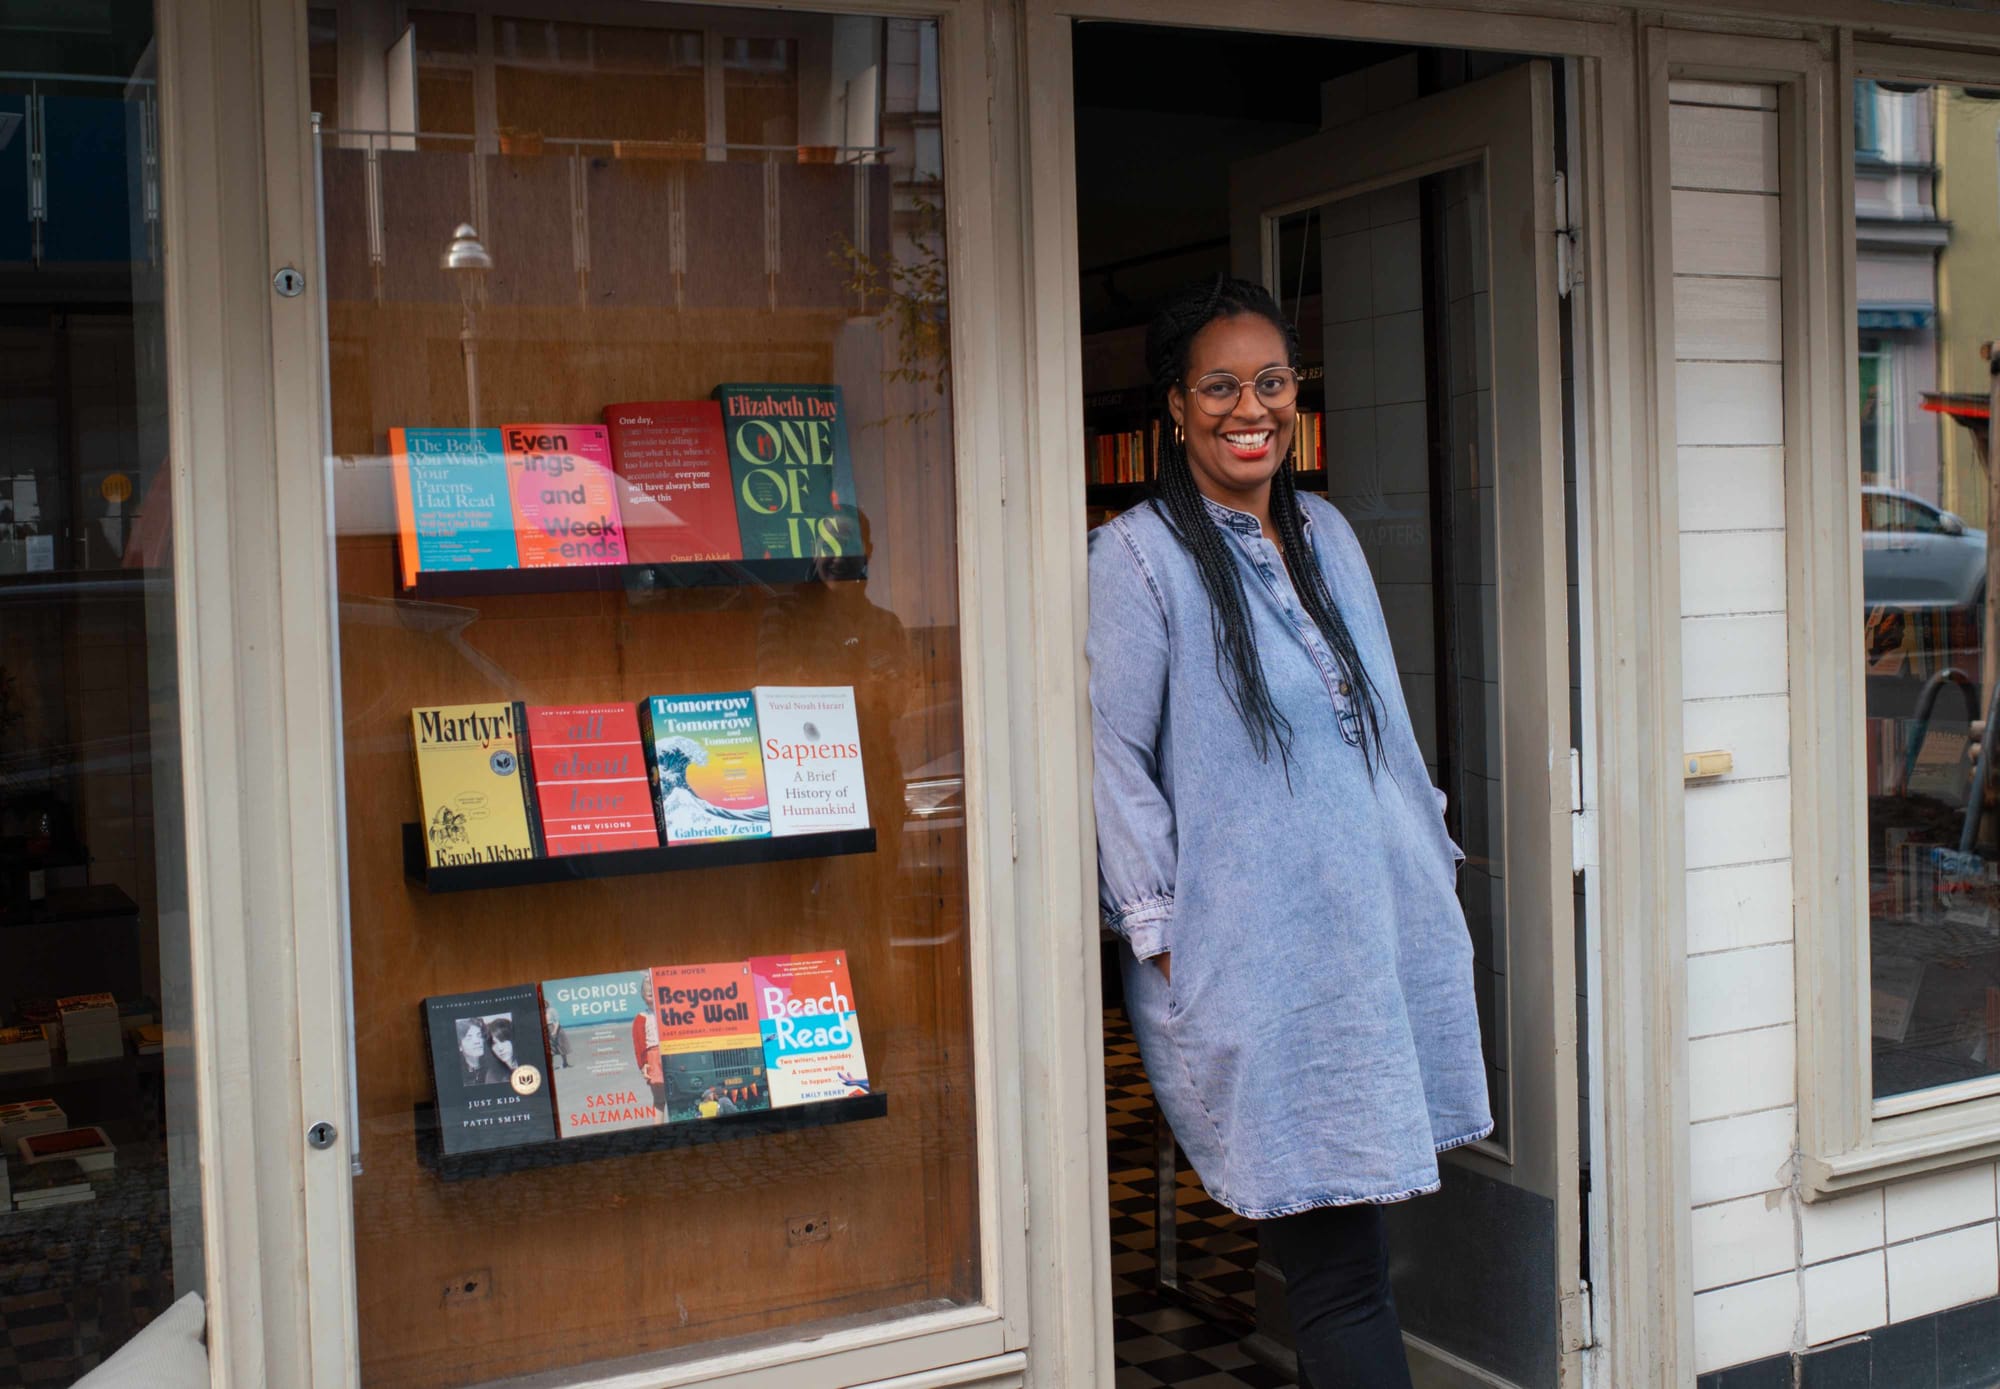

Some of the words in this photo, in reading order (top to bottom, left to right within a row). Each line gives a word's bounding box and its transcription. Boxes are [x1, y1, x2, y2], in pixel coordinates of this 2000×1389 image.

[728, 395, 804, 417] Elizabeth
[806, 397, 838, 422] Day
[619, 417, 636, 425] One
[637, 416, 654, 426] day,
[409, 439, 442, 452] The
[446, 439, 487, 452] Book
[509, 431, 568, 451] Even
[736, 419, 834, 466] ONE
[412, 453, 442, 465] You
[445, 452, 485, 465] Wish
[414, 467, 449, 480] Your
[674, 470, 711, 480] everyone
[416, 480, 473, 493] Parents
[540, 484, 586, 504] and
[628, 482, 643, 492] will
[644, 481, 664, 491] have
[665, 481, 691, 492] always
[692, 480, 711, 489] been
[742, 468, 810, 515] OF
[418, 494, 451, 507] Had
[456, 493, 495, 508] Read
[657, 493, 672, 502] this
[543, 515, 617, 537] Week
[786, 517, 844, 558] US
[1357, 524, 1425, 546] HAPTERS
[670, 553, 693, 562] Omar
[694, 553, 703, 561] El
[704, 551, 731, 561] Akkad
[653, 697, 750, 714] Tomorrow
[723, 710, 739, 718] and
[769, 701, 792, 710] Yuval
[794, 701, 816, 710] Noah
[818, 701, 845, 710] Harari
[418, 706, 513, 749] Martyr!
[567, 715, 604, 740] all
[663, 717, 753, 733] Tomorrow
[703, 735, 754, 746] Tomorrow
[766, 738, 859, 767] Sapiens
[552, 751, 629, 776] about
[794, 771, 803, 782] A
[807, 770, 838, 782] Brief
[569, 787, 625, 812] love
[785, 787, 832, 801] History
[835, 786, 849, 798] of
[782, 803, 856, 817] Humankind
[571, 823, 591, 831] NEW
[595, 821, 632, 830] VISIONS
[674, 825, 729, 840] Gabrielle
[730, 823, 763, 835] Zevin
[435, 847, 482, 868] Kaveh
[486, 844, 531, 862] Akbar
[655, 969, 677, 977] KATJA
[556, 981, 638, 1002] GLORIOUS
[658, 981, 739, 1009] Beyond
[571, 999, 628, 1017] PEOPLE
[763, 981, 850, 1020] Beach
[660, 1007, 696, 1027] the
[703, 1002, 749, 1023] Wall
[775, 1013, 849, 1050] Read
[468, 1098, 493, 1109] JUST
[496, 1095, 521, 1105] KIDS
[586, 1091, 638, 1108] SASHA
[800, 1091, 822, 1099] EMILY
[823, 1088, 846, 1097] HENRY
[463, 1117, 494, 1128] PATTI
[498, 1113, 531, 1125] SMITH
[570, 1106, 657, 1127] SALZMANN
